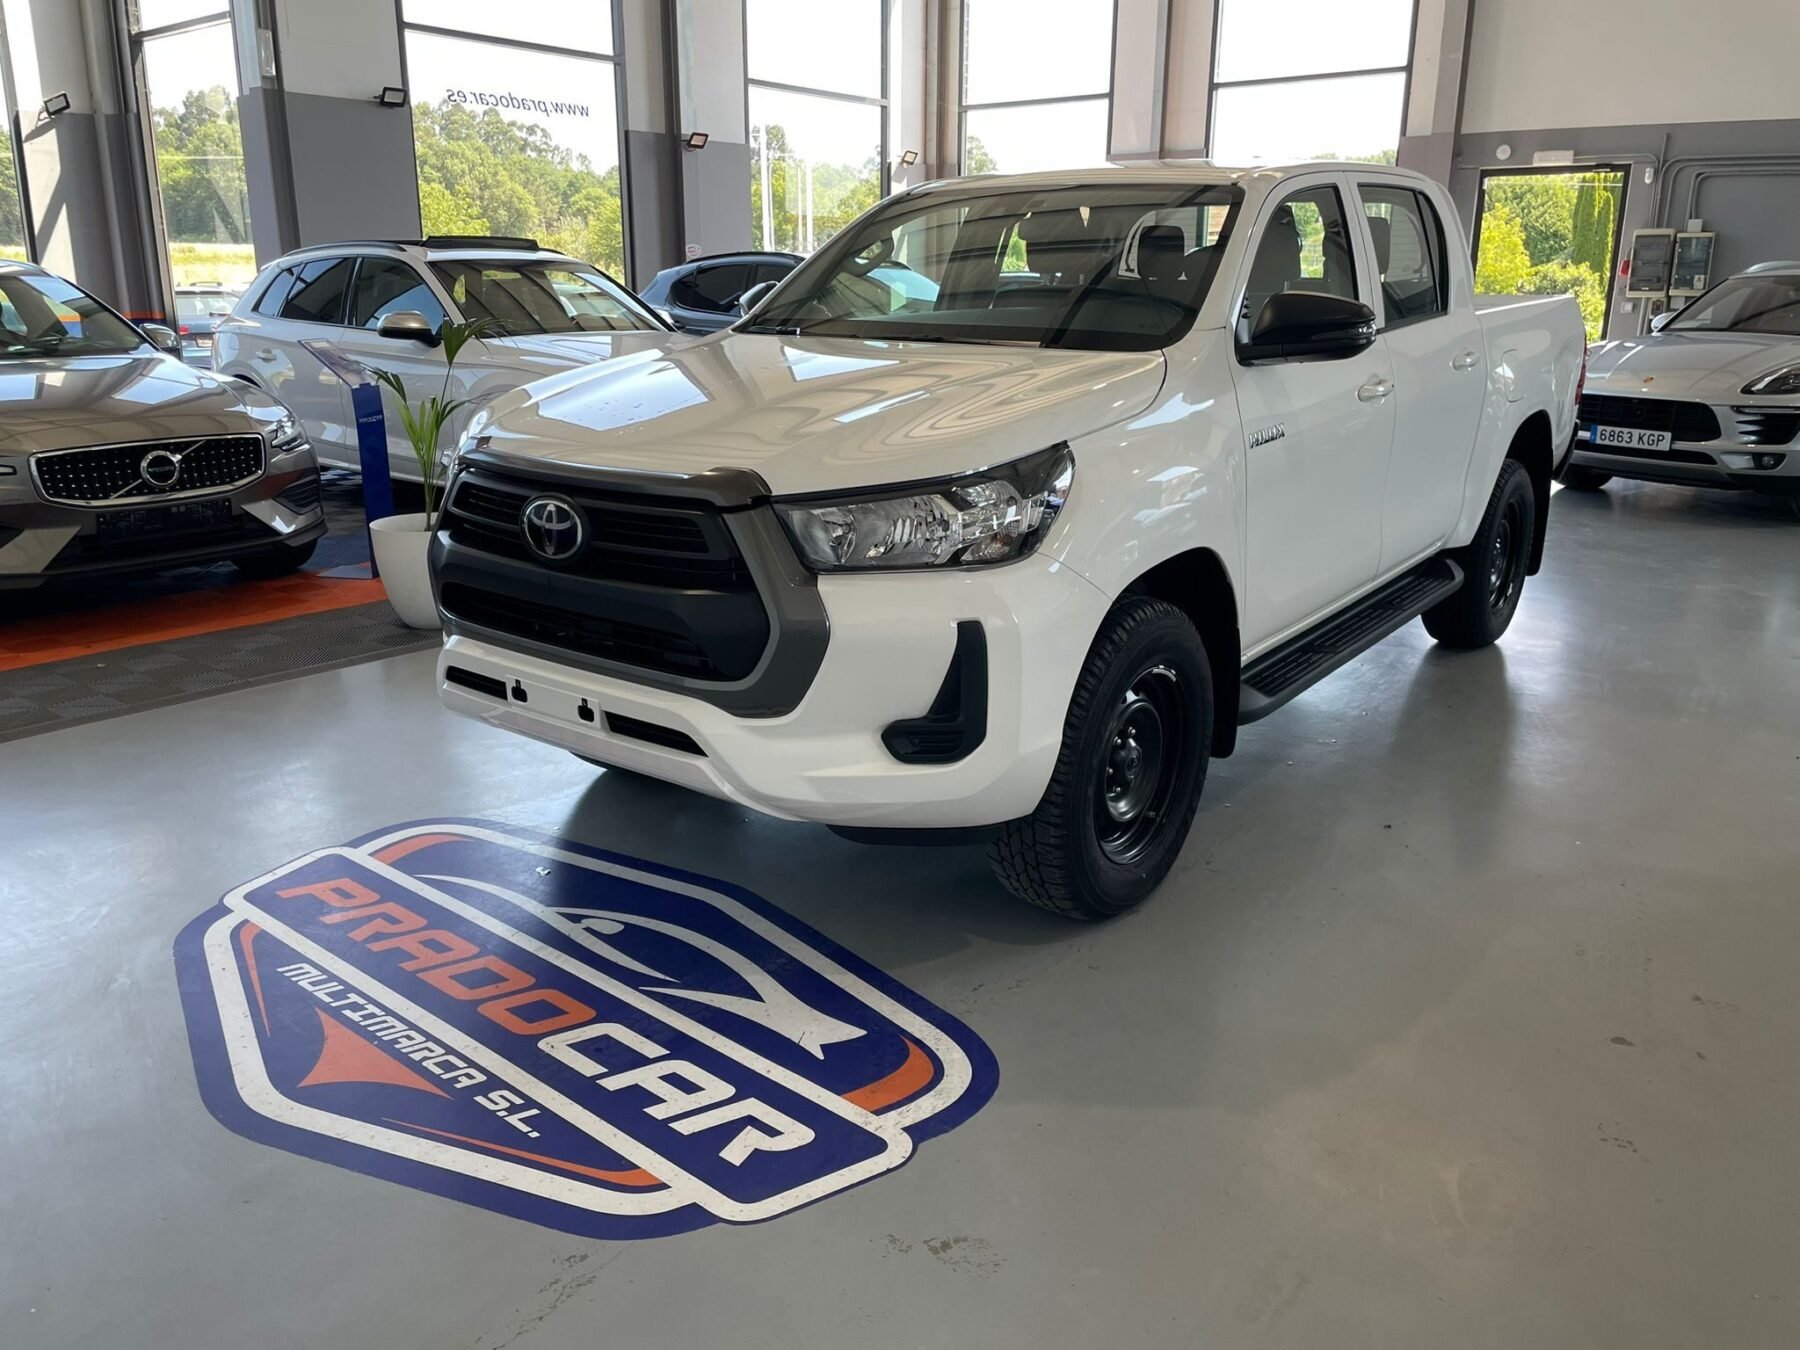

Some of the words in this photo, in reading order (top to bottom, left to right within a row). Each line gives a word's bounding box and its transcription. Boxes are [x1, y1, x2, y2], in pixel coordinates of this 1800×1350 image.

[1600, 428, 1633, 444] 6863
[1637, 431, 1665, 447] KGP
[275, 877, 815, 1167] PRADOCAR
[276, 962, 487, 1089] MULTIMARCA
[473, 1089, 541, 1138] S.L.
